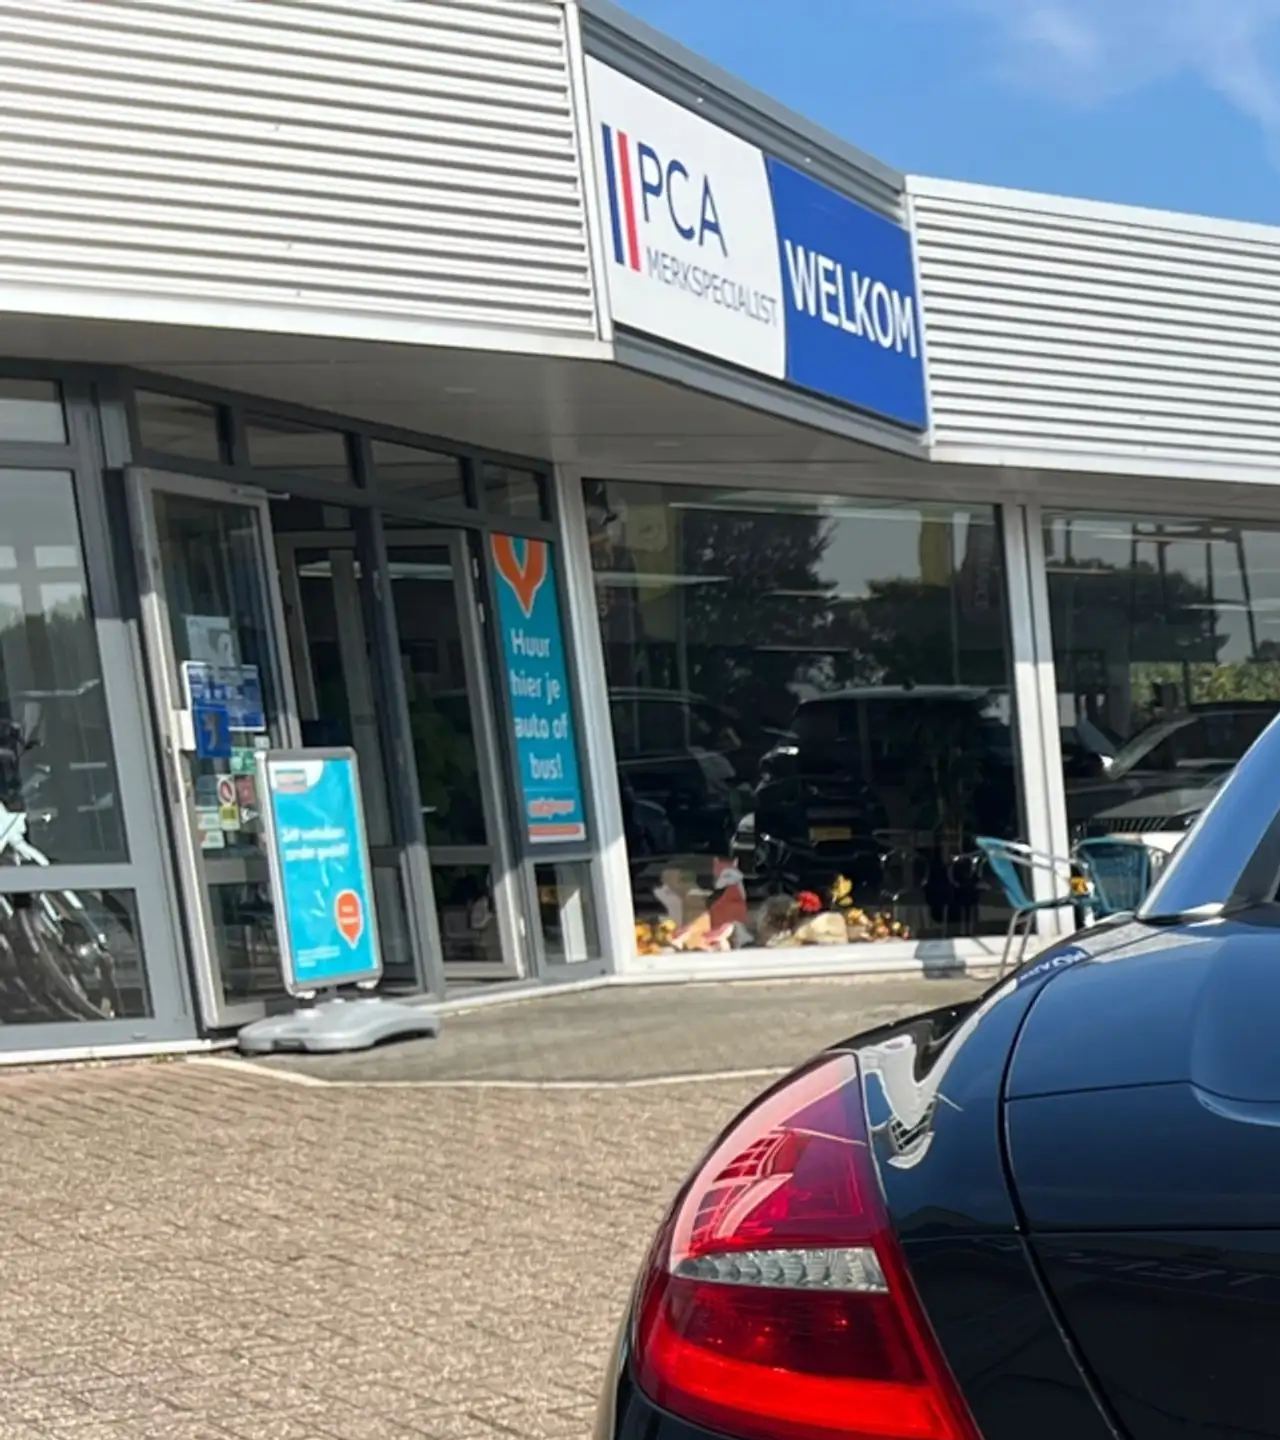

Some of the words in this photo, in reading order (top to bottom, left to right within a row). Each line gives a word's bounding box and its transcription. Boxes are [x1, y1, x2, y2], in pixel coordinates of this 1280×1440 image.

[637, 141, 728, 258] PCA
[646, 246, 778, 327] MERKSPECIALIST
[784, 239, 917, 358] WELKOM
[510, 628, 550, 657] Huur
[510, 669, 542, 697] hier
[543, 671, 562, 705] je
[514, 713, 549, 739] auto
[551, 712, 568, 739] of
[528, 752, 563, 780] bus!
